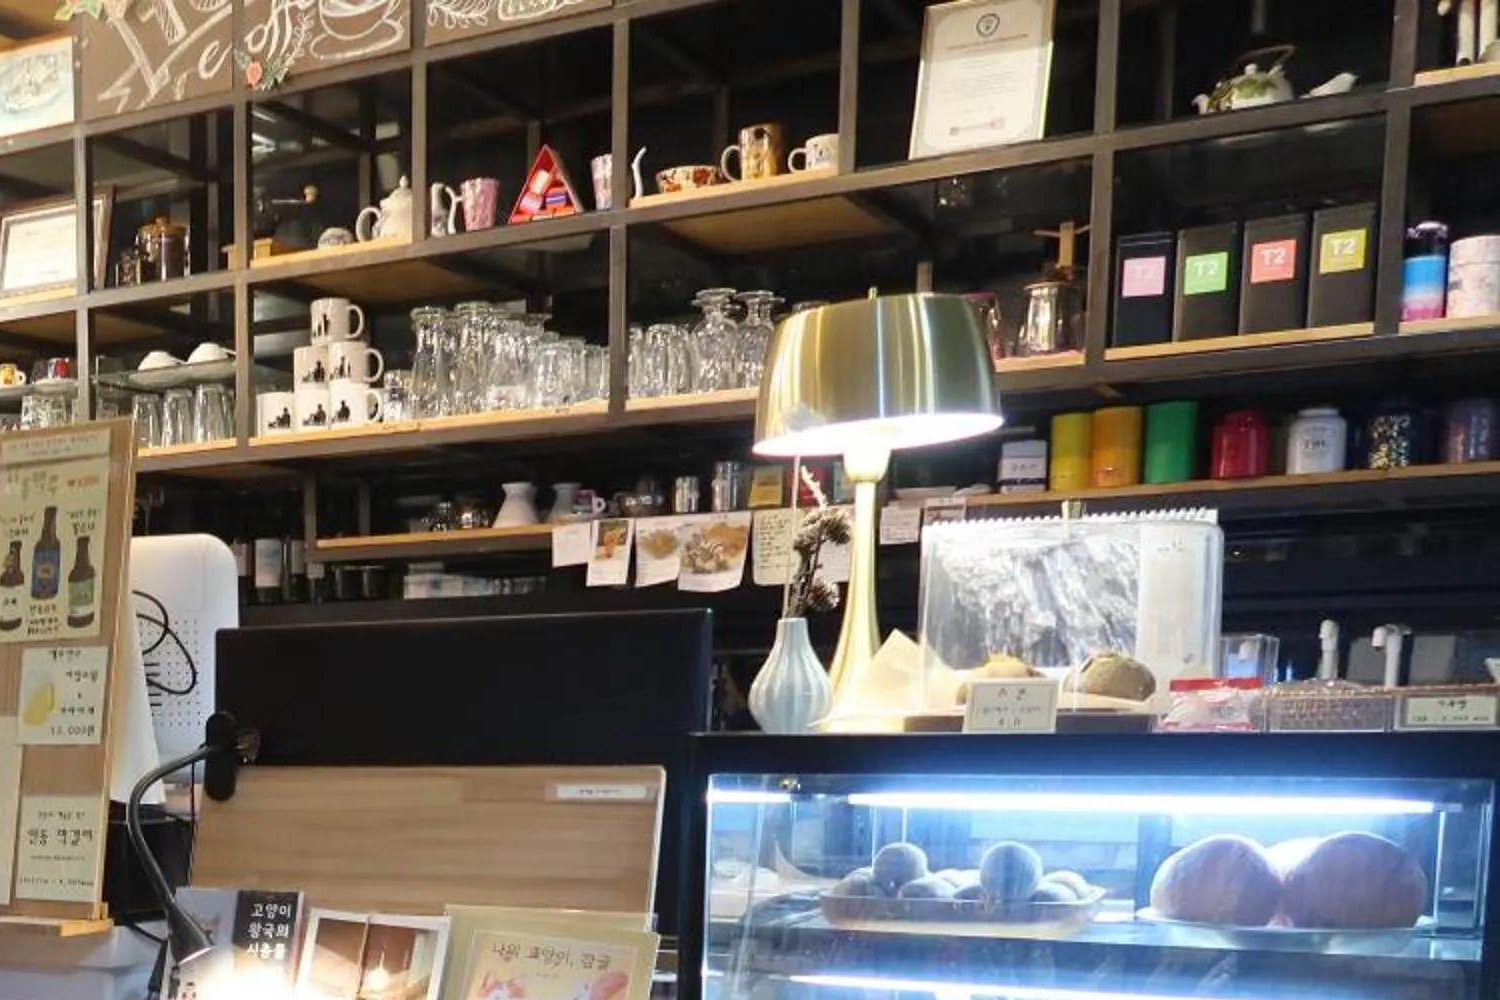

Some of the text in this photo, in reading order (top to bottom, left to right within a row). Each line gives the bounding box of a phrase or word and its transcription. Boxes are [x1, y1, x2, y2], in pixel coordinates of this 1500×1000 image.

[1331, 238, 1355, 256] T2
[1259, 248, 1286, 266] T2
[1193, 260, 1218, 278] T2
[251, 904, 292, 919] 고양이
[247, 923, 290, 939] 왕국의
